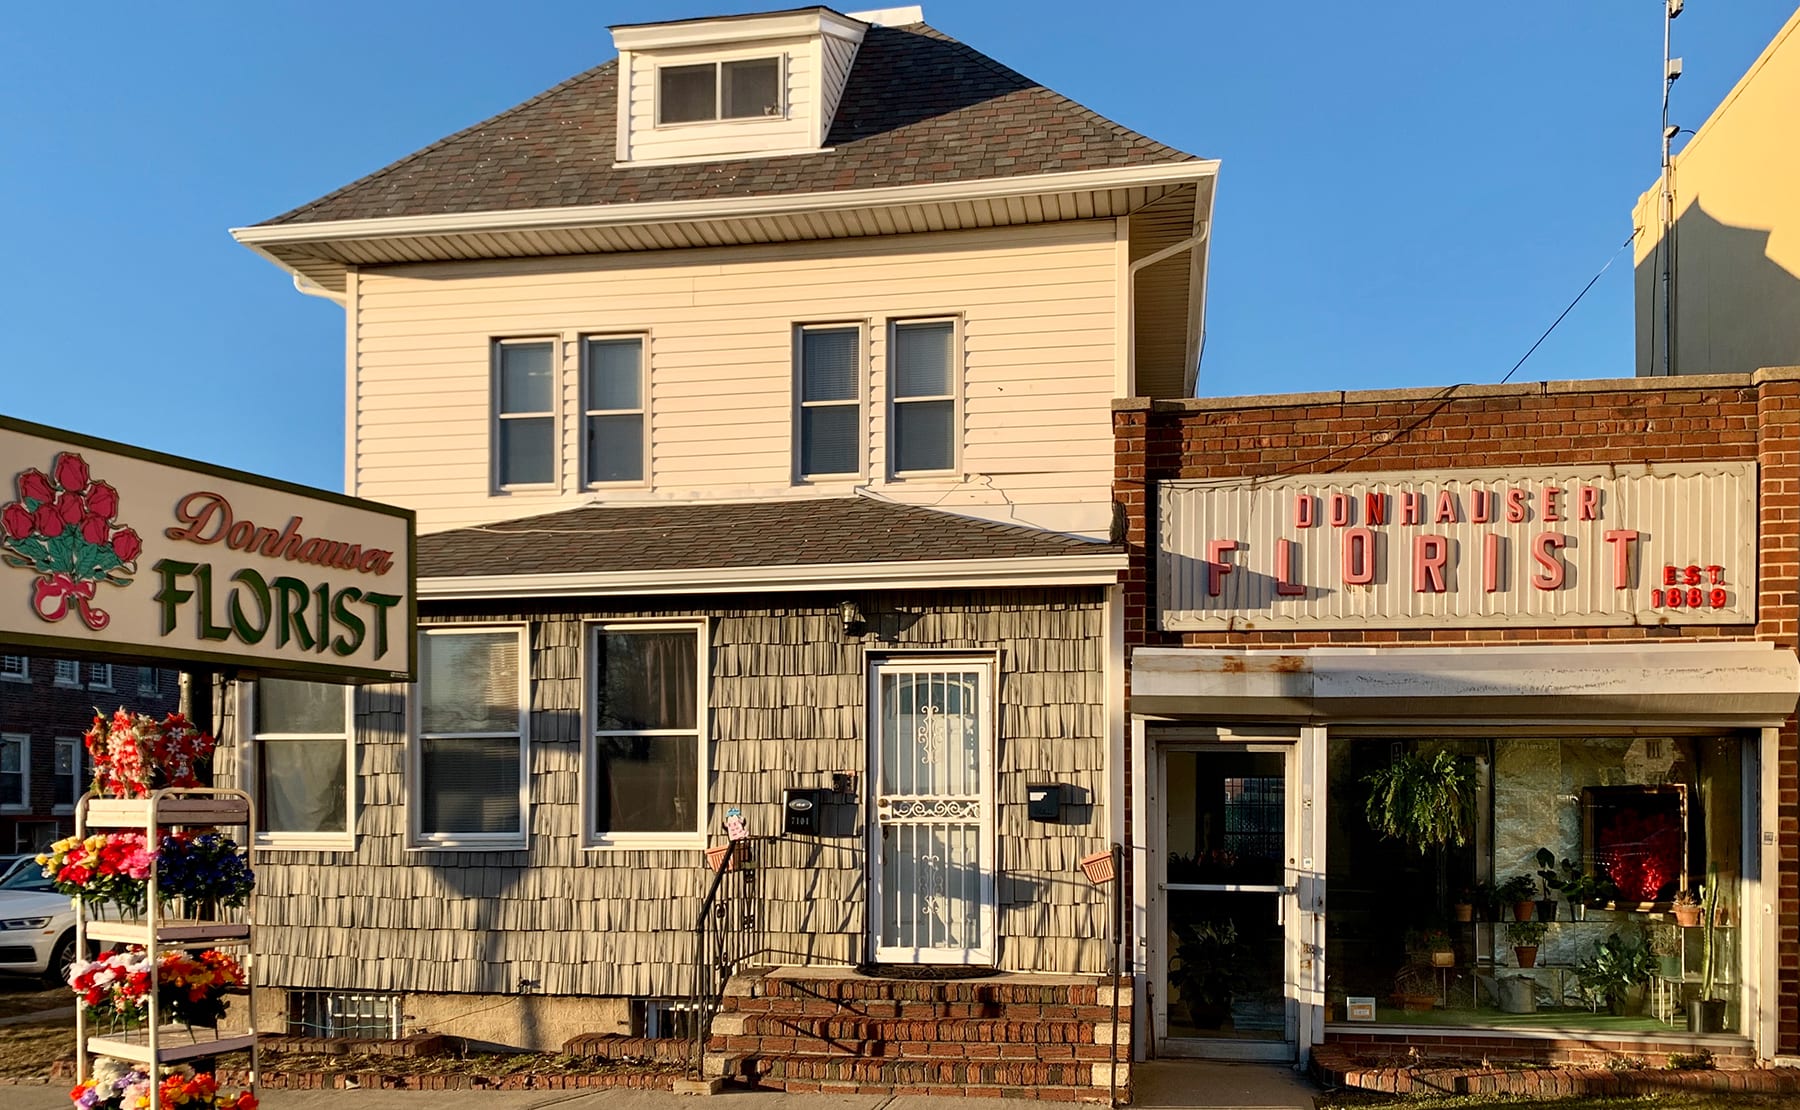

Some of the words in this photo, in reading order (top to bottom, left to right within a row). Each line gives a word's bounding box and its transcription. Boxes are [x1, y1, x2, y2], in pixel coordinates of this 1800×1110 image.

[165, 490, 394, 577] Donhauser
[1294, 486, 1599, 529] DONHAUSER
[1207, 527, 1640, 598] FLORIST
[1663, 565, 1726, 586] EST.
[152, 558, 403, 661] FLORIST
[1651, 587, 1727, 609] 1889
